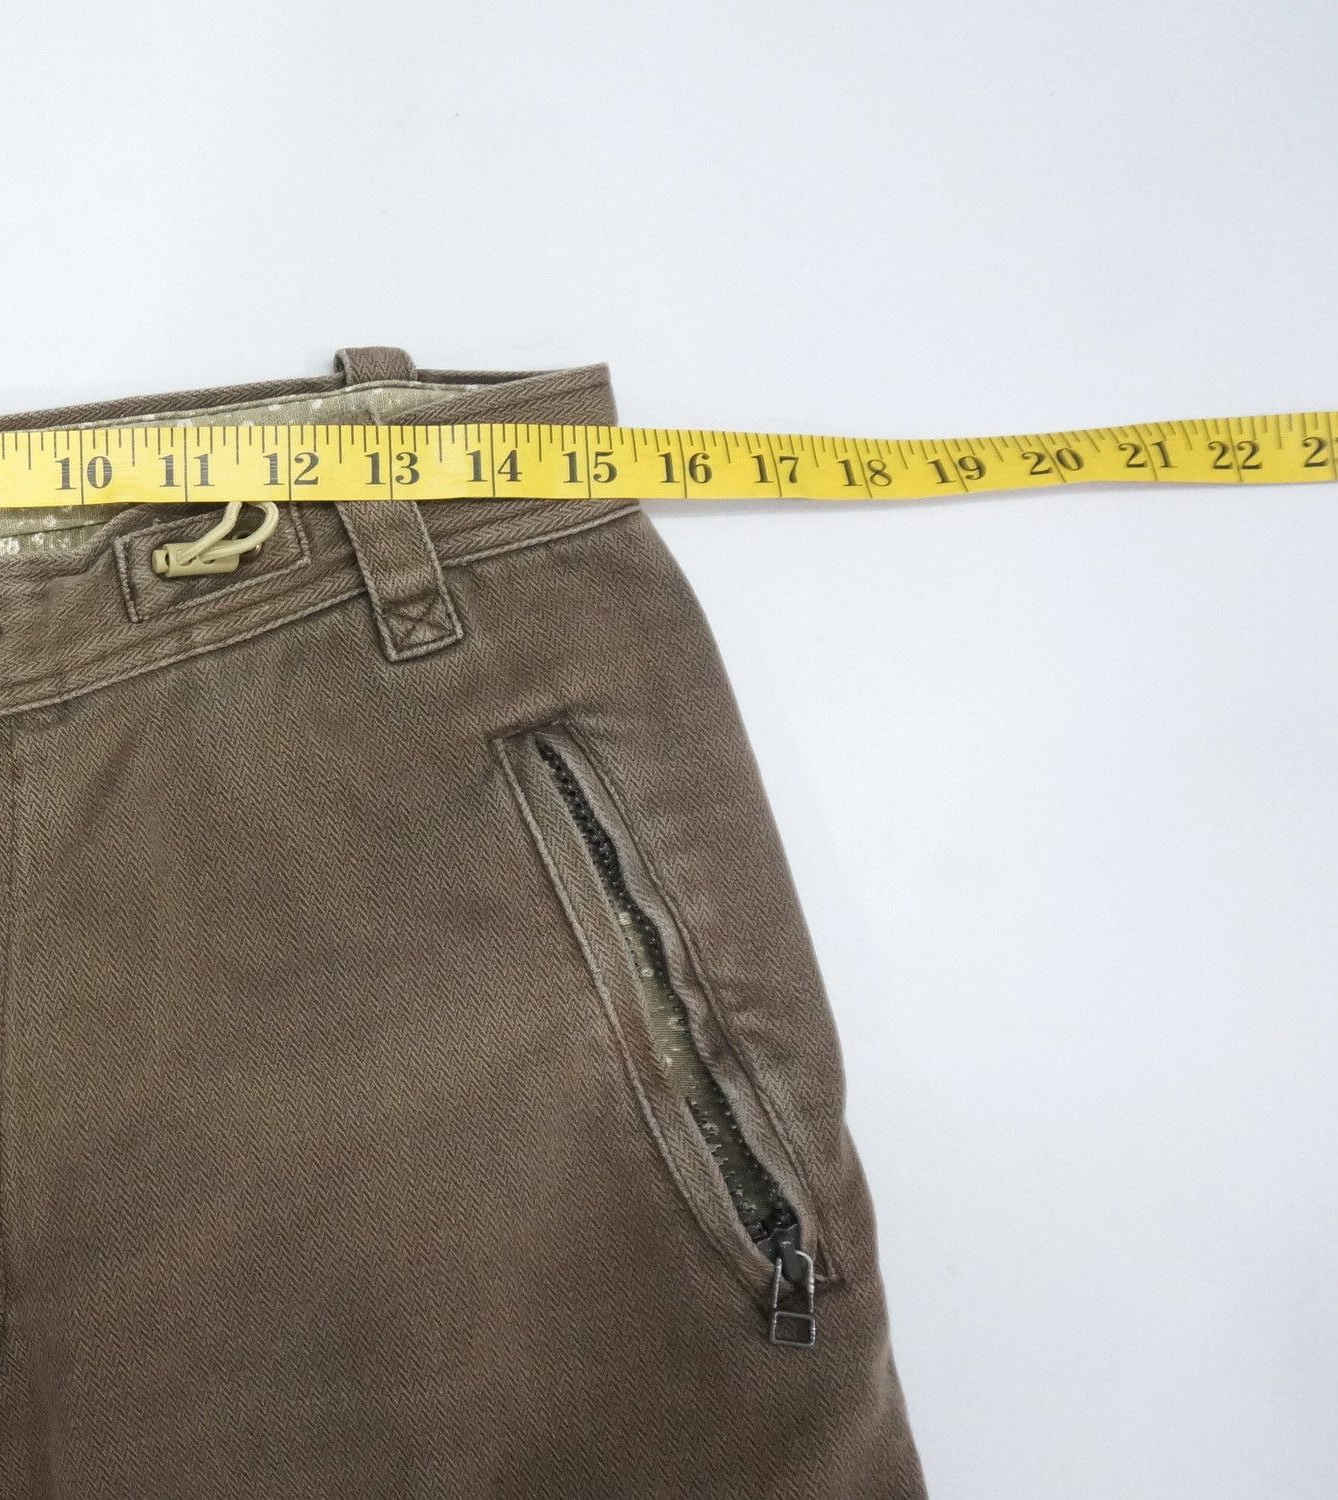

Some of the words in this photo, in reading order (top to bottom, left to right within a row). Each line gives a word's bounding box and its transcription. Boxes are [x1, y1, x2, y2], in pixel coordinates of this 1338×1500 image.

[55, 455, 113, 490] 10
[159, 454, 215, 487] 11
[263, 453, 319, 486] 12
[364, 452, 420, 485] 13
[466, 450, 522, 483] 14
[562, 450, 617, 483] 15
[659, 451, 713, 486] 16
[751, 454, 800, 484] 17
[840, 459, 893, 488] 18
[926, 456, 987, 485] 19
[1021, 447, 1085, 477] 20
[1118, 441, 1178, 469] 21
[1207, 440, 1262, 471] 22
[1302, 436, 1338, 470] 2
